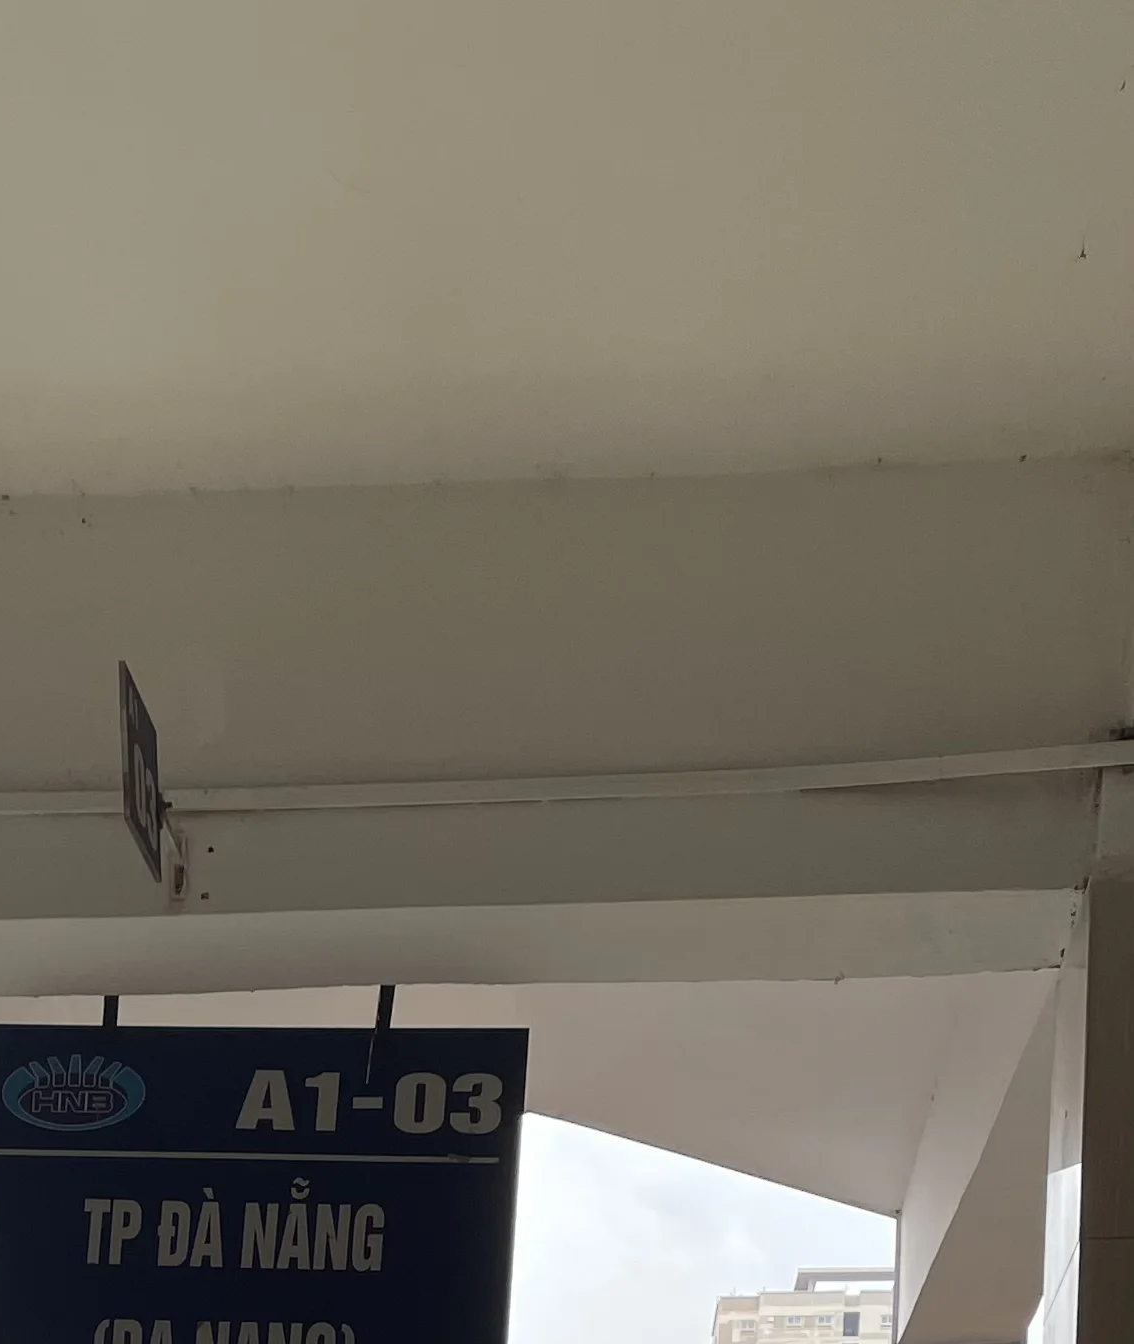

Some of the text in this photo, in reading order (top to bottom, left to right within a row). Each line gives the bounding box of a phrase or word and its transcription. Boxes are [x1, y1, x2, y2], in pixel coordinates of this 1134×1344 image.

[31, 1089, 114, 1113] HNB
[235, 1069, 504, 1135] A1-03
[83, 1177, 385, 1272] TP ĐÀ NẴNG
